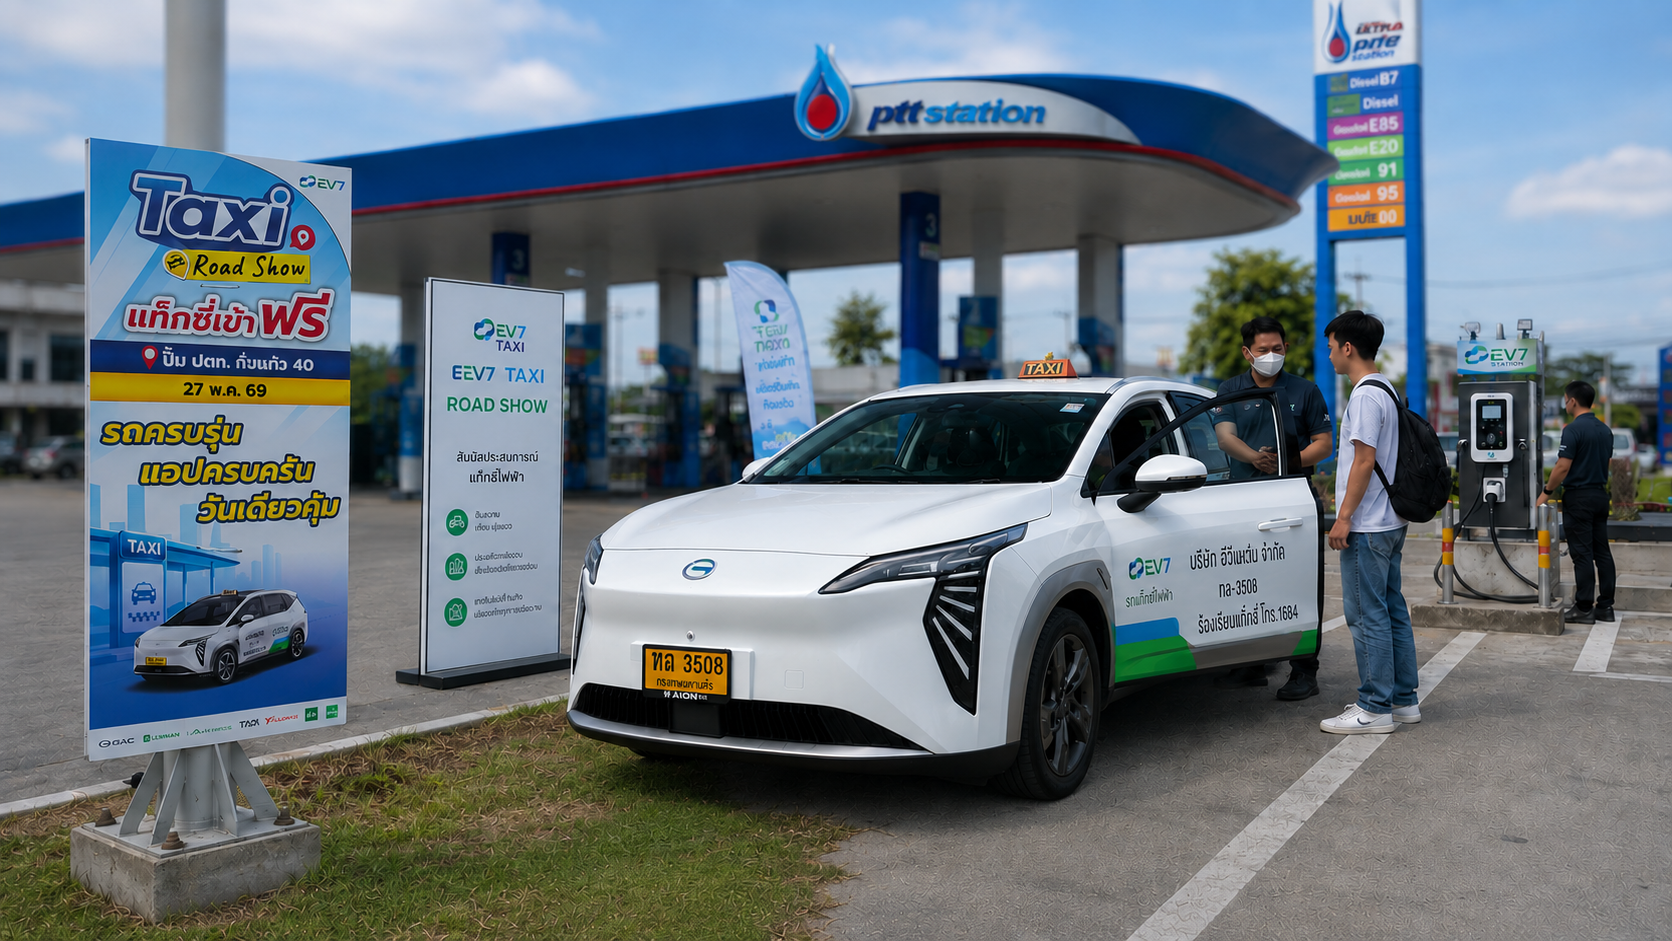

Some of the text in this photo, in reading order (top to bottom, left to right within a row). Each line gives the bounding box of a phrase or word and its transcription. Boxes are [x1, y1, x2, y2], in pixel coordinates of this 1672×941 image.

[1380, 71, 1399, 86] B7
[867, 98, 1046, 132] ptt station
[1369, 116, 1399, 133] E85
[1369, 139, 1399, 156] E20
[1378, 162, 1397, 178] 91
[317, 177, 345, 191] EV7
[1377, 185, 1399, 201] 95
[132, 171, 292, 248] Taxi
[924, 213, 937, 238] 3
[193, 254, 306, 278] Road Show
[125, 291, 332, 339] แท็กซี่เข้า ฟรี
[496, 323, 527, 339] EV7
[496, 340, 525, 352] TAXI
[1490, 348, 1528, 361] EV7
[162, 346, 187, 368] ปั๊ม
[192, 353, 231, 369] ปตท.
[293, 358, 314, 372] 40
[452, 364, 545, 384] EEV7 TAXI
[1026, 362, 1062, 375] TAXI
[183, 381, 267, 398] 27 พ.ค. 69
[447, 396, 548, 414] ROAD SHOW
[101, 415, 244, 454] รถครบรุ่น
[196, 491, 341, 527] วันเดียวคุ้ม
[127, 538, 161, 556] TAXI
[1145, 557, 1171, 576] EV7
[683, 653, 724, 676] 3508
[672, 691, 698, 700] AION
